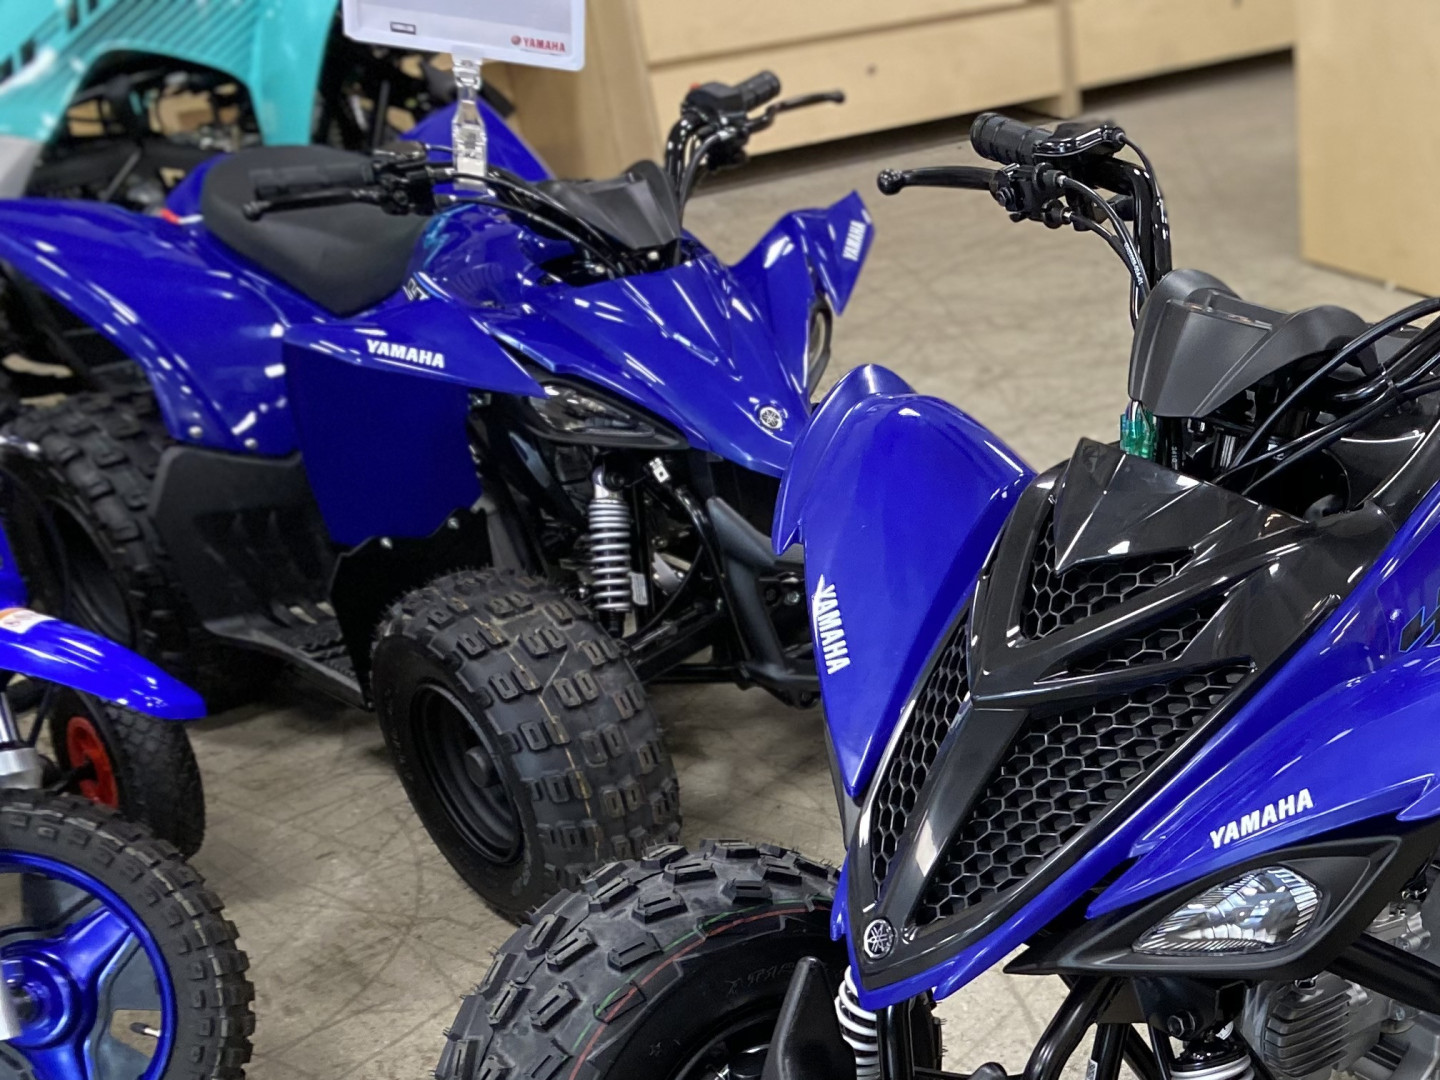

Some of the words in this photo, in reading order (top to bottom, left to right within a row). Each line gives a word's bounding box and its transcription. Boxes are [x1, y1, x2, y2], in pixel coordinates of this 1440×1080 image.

[523, 36, 566, 52] YAMAHA
[843, 220, 866, 261] YAMAHA
[366, 339, 445, 369] YAMAHA
[818, 584, 851, 675] YAMAHA
[1209, 788, 1314, 849] YAMAHA
